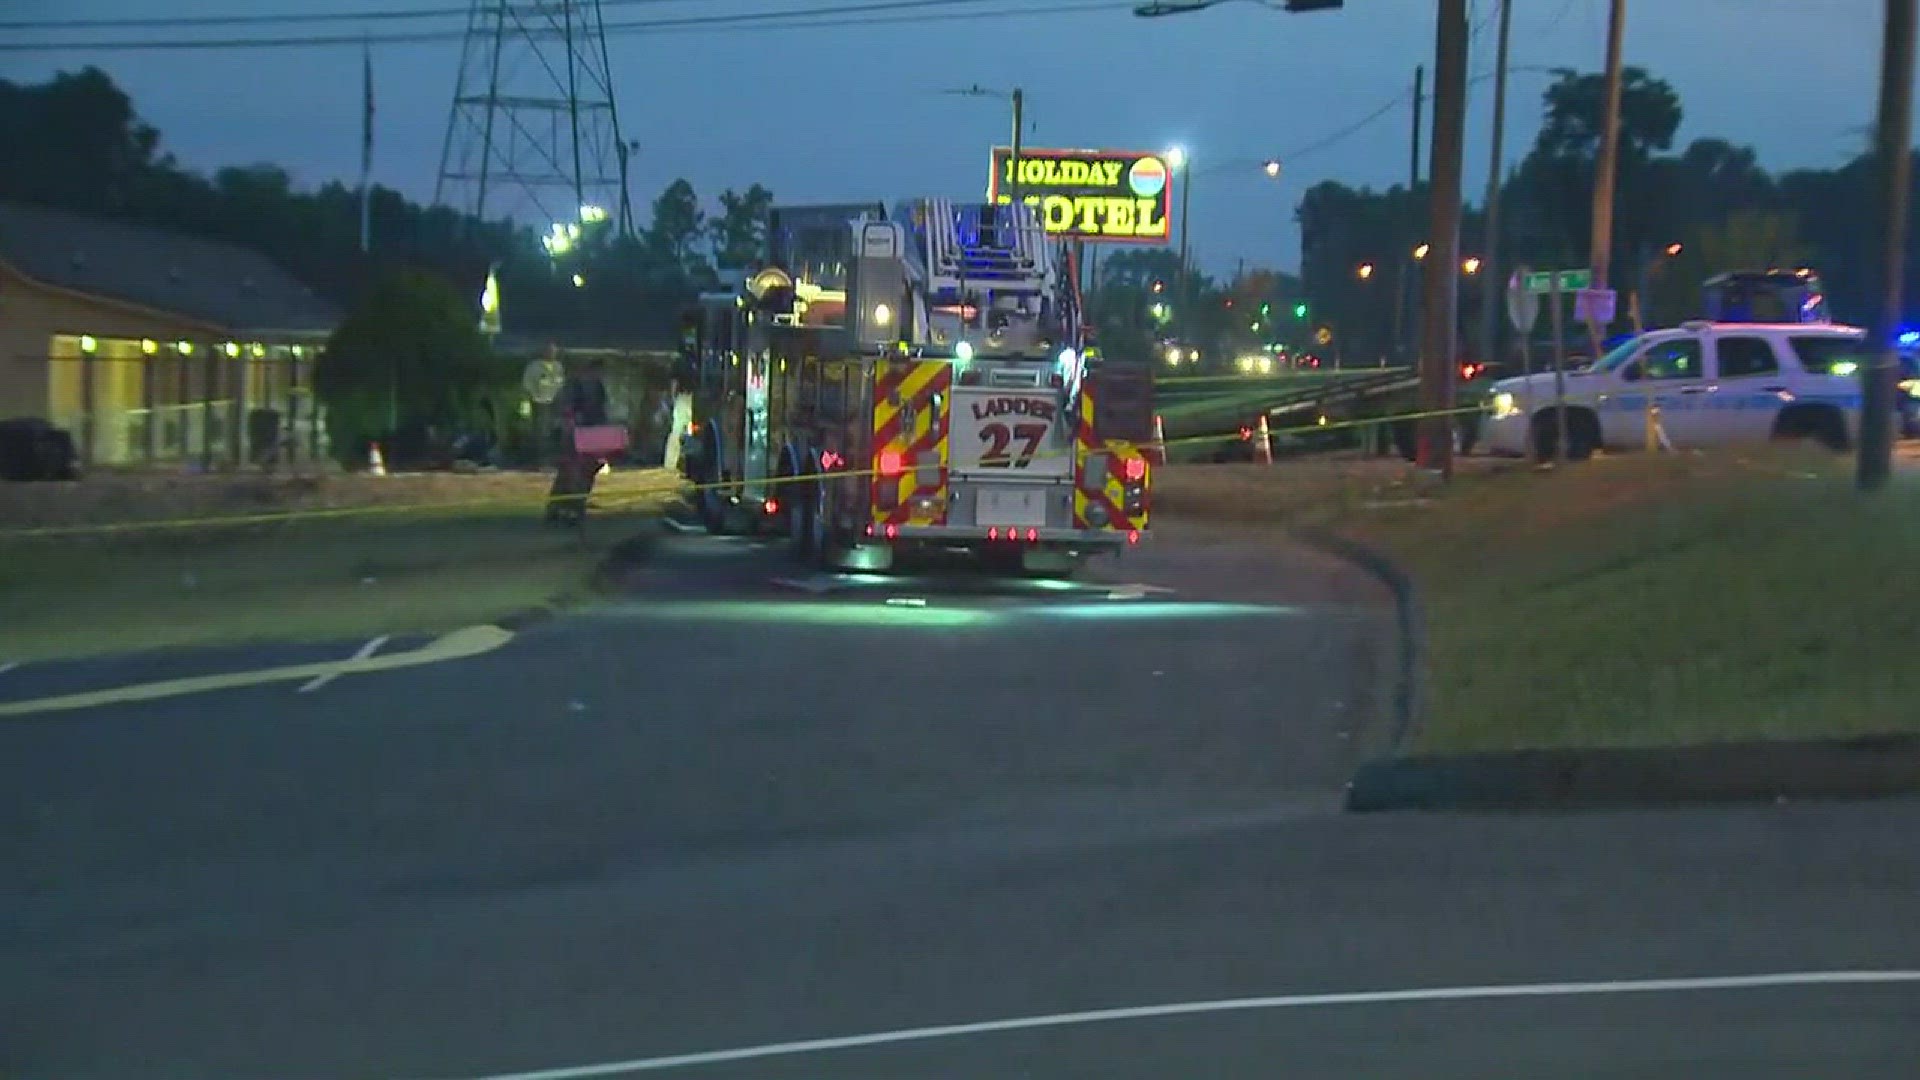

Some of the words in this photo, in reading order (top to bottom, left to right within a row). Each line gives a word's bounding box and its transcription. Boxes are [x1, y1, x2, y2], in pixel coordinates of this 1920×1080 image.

[1006, 158, 1123, 185] HOLIDAY
[997, 195, 1166, 235] OTEL
[971, 397, 1056, 422] LADDER
[979, 423, 1048, 468] 27
